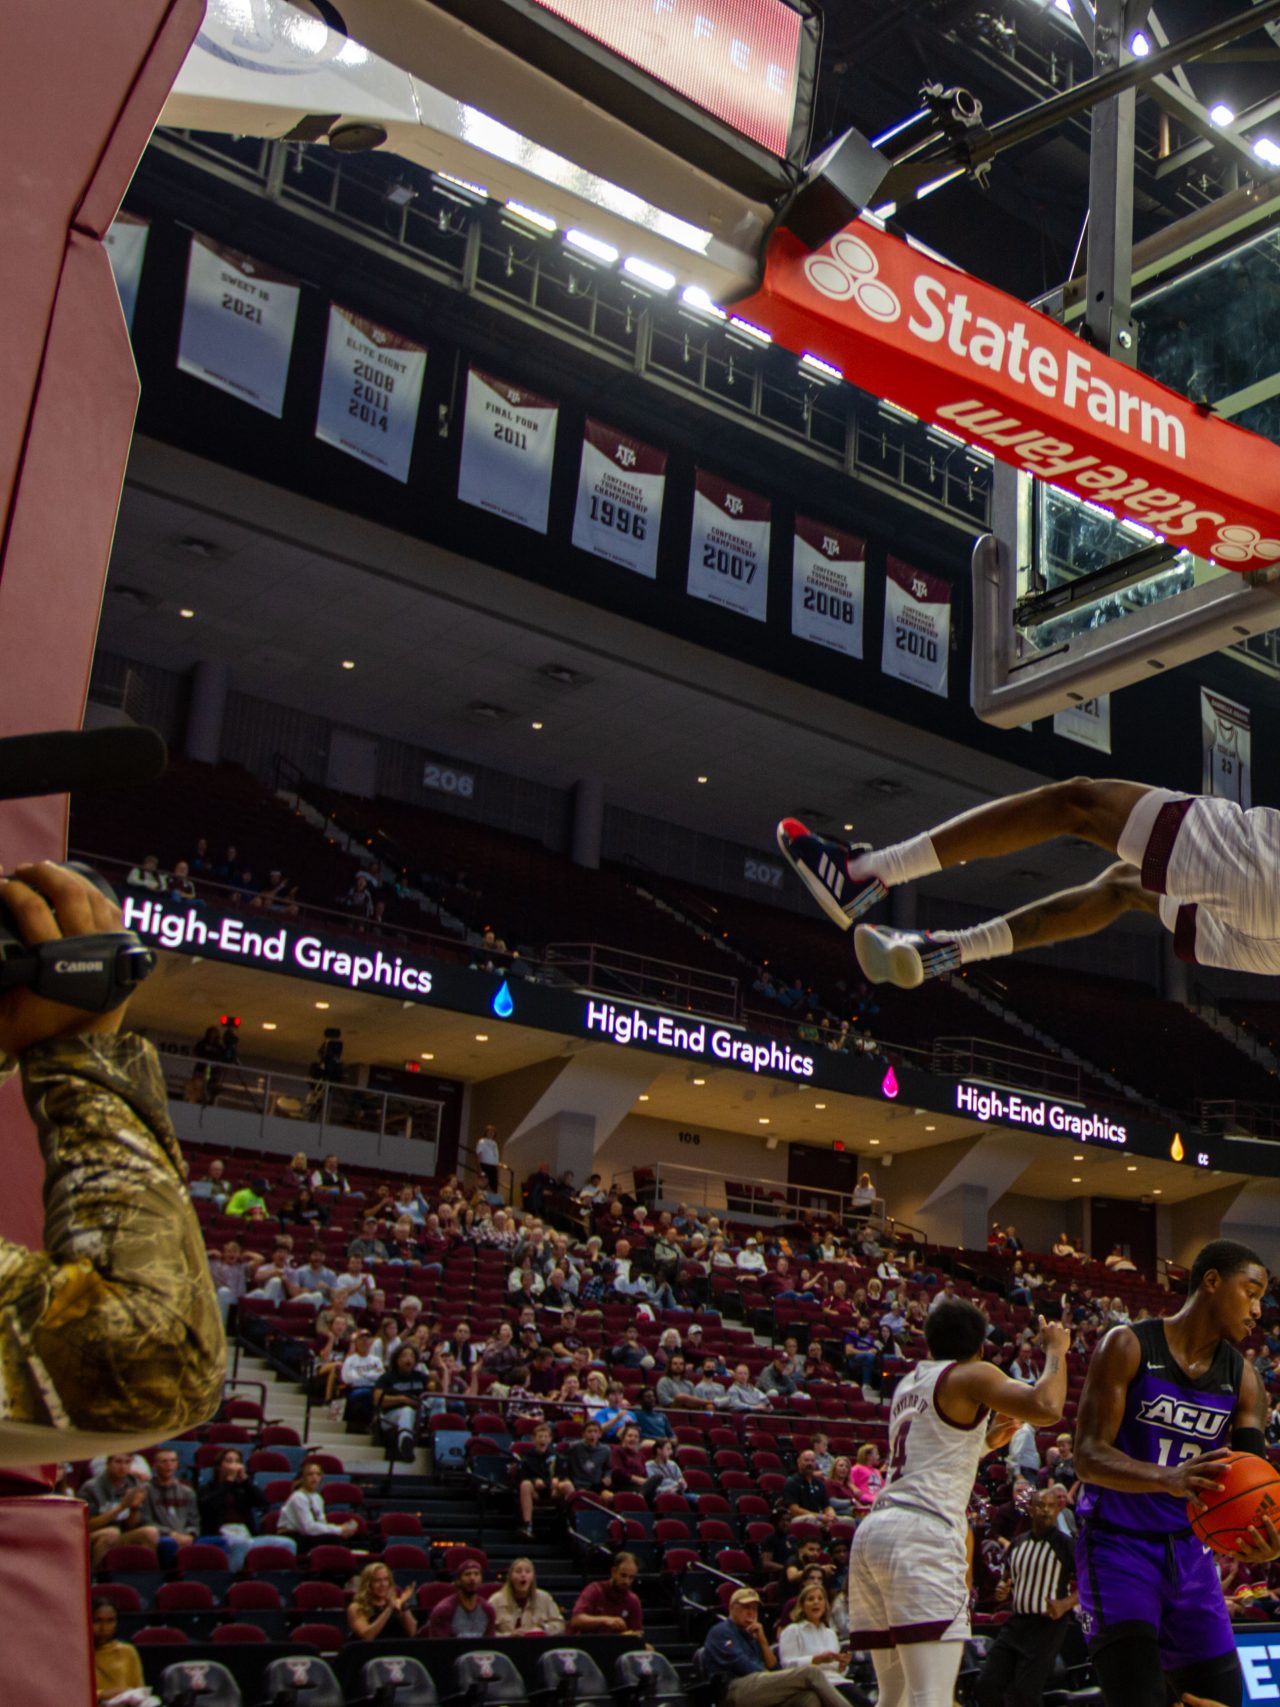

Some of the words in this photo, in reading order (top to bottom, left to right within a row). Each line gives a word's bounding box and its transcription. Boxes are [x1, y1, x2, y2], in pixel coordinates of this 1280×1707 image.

[220, 272, 256, 296] SWEET
[221, 293, 263, 325] 2021
[346, 337, 375, 359] ELITE
[378, 351, 407, 375] EIGHT
[353, 359, 395, 394] 2008
[353, 380, 390, 413] 2011
[348, 399, 389, 434] 2014
[485, 401, 513, 421] FINAL
[515, 413, 539, 433] FOUR
[494, 423, 527, 450] 2011
[594, 484, 649, 514] CHAMPIONSHIP
[603, 472, 643, 496] CONFERENCE
[589, 496, 648, 541] 1996
[706, 533, 757, 559] CHAMPIONSHIP
[711, 526, 753, 548] CONFERENCE
[702, 543, 758, 585] 2007
[806, 577, 853, 599] CHAMPIONSHIP
[803, 586, 855, 625] 2008
[895, 626, 939, 664] 2010
[423, 766, 474, 796] 206
[744, 861, 783, 887] 207
[123, 897, 287, 963] High-End
[294, 936, 433, 993] Graphics
[55, 960, 104, 975] Canon
[587, 1001, 705, 1053] High-End
[711, 1030, 814, 1077] Graphics
[956, 1084, 1045, 1127] High-End
[1049, 1106, 1127, 1143] Graphics
[1145, 1399, 1225, 1436] ACU
